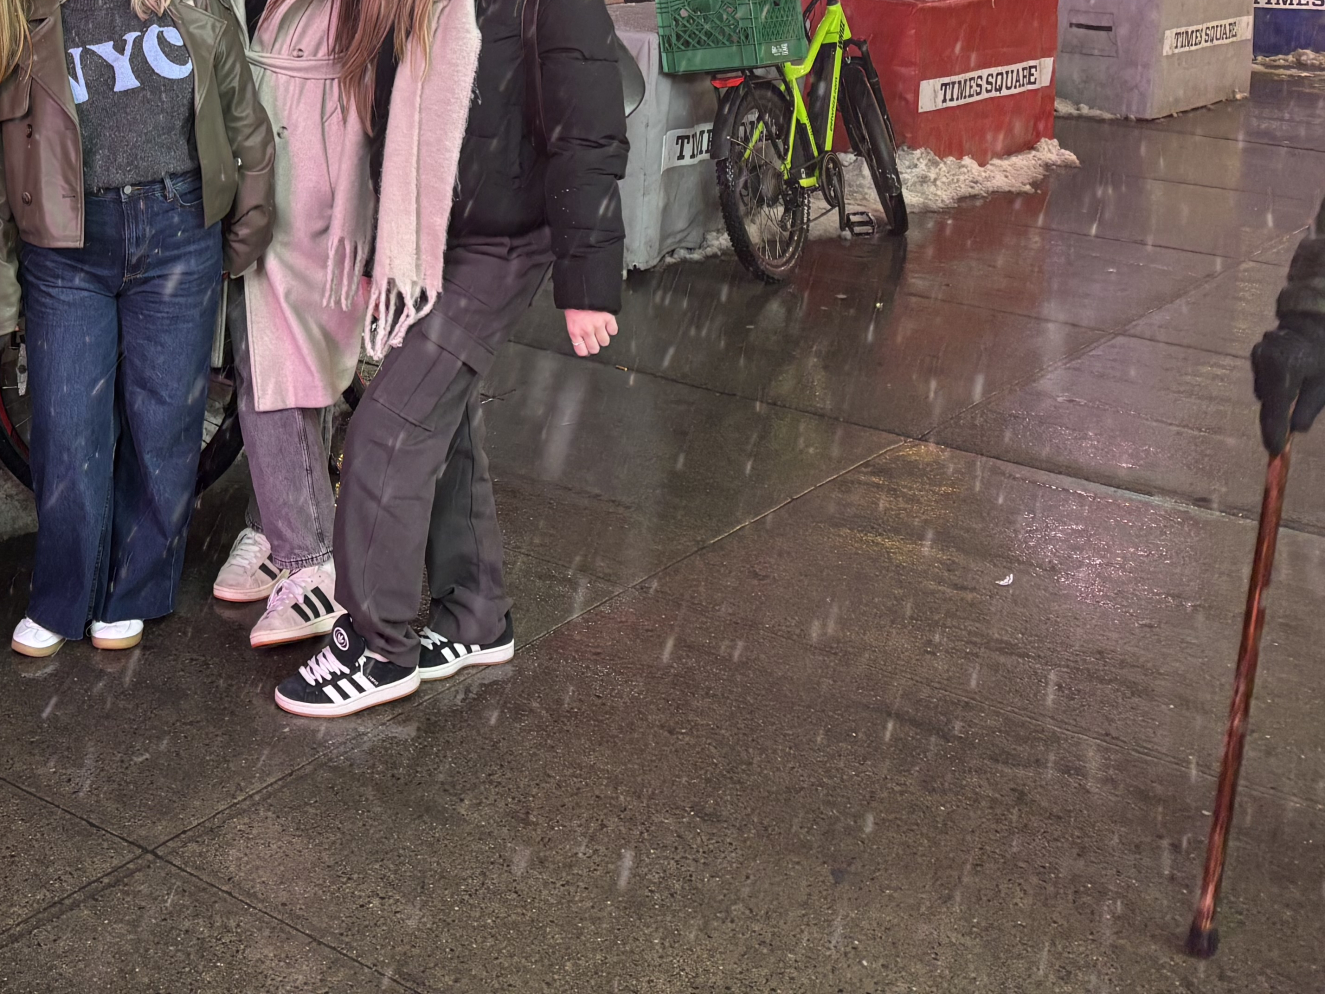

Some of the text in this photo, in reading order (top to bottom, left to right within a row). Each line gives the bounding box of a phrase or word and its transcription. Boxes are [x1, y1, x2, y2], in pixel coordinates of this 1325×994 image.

[1174, 21, 1238, 49] TIMES SQUARE
[66, 24, 193, 105] NYC
[940, 64, 1038, 104] TIMES SQUARE
